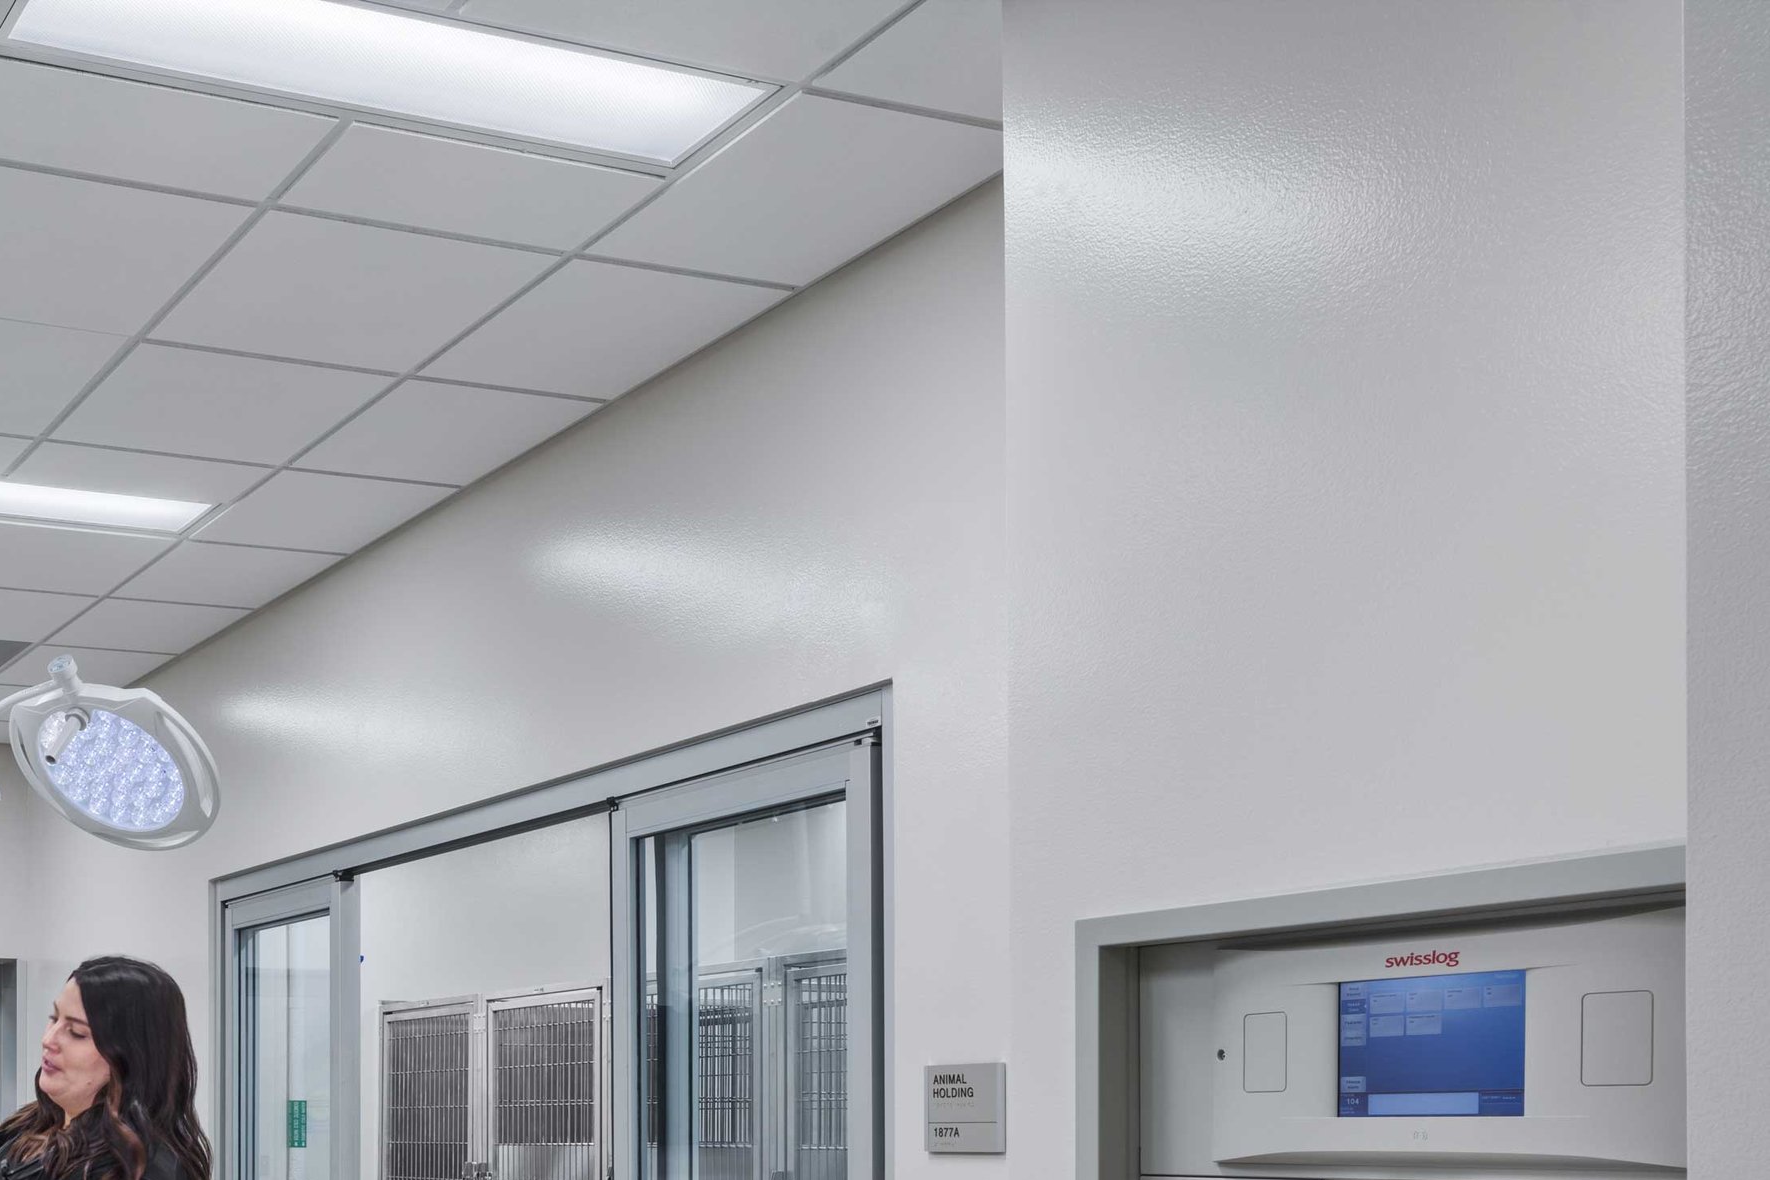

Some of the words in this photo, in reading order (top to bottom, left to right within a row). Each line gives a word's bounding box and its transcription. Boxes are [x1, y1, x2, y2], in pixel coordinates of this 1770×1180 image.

[1385, 950, 1460, 968] swisslog
[933, 1073, 967, 1085] ANIMAL
[932, 1087, 974, 1098] HOLDING
[934, 1127, 960, 1138] 1877A
